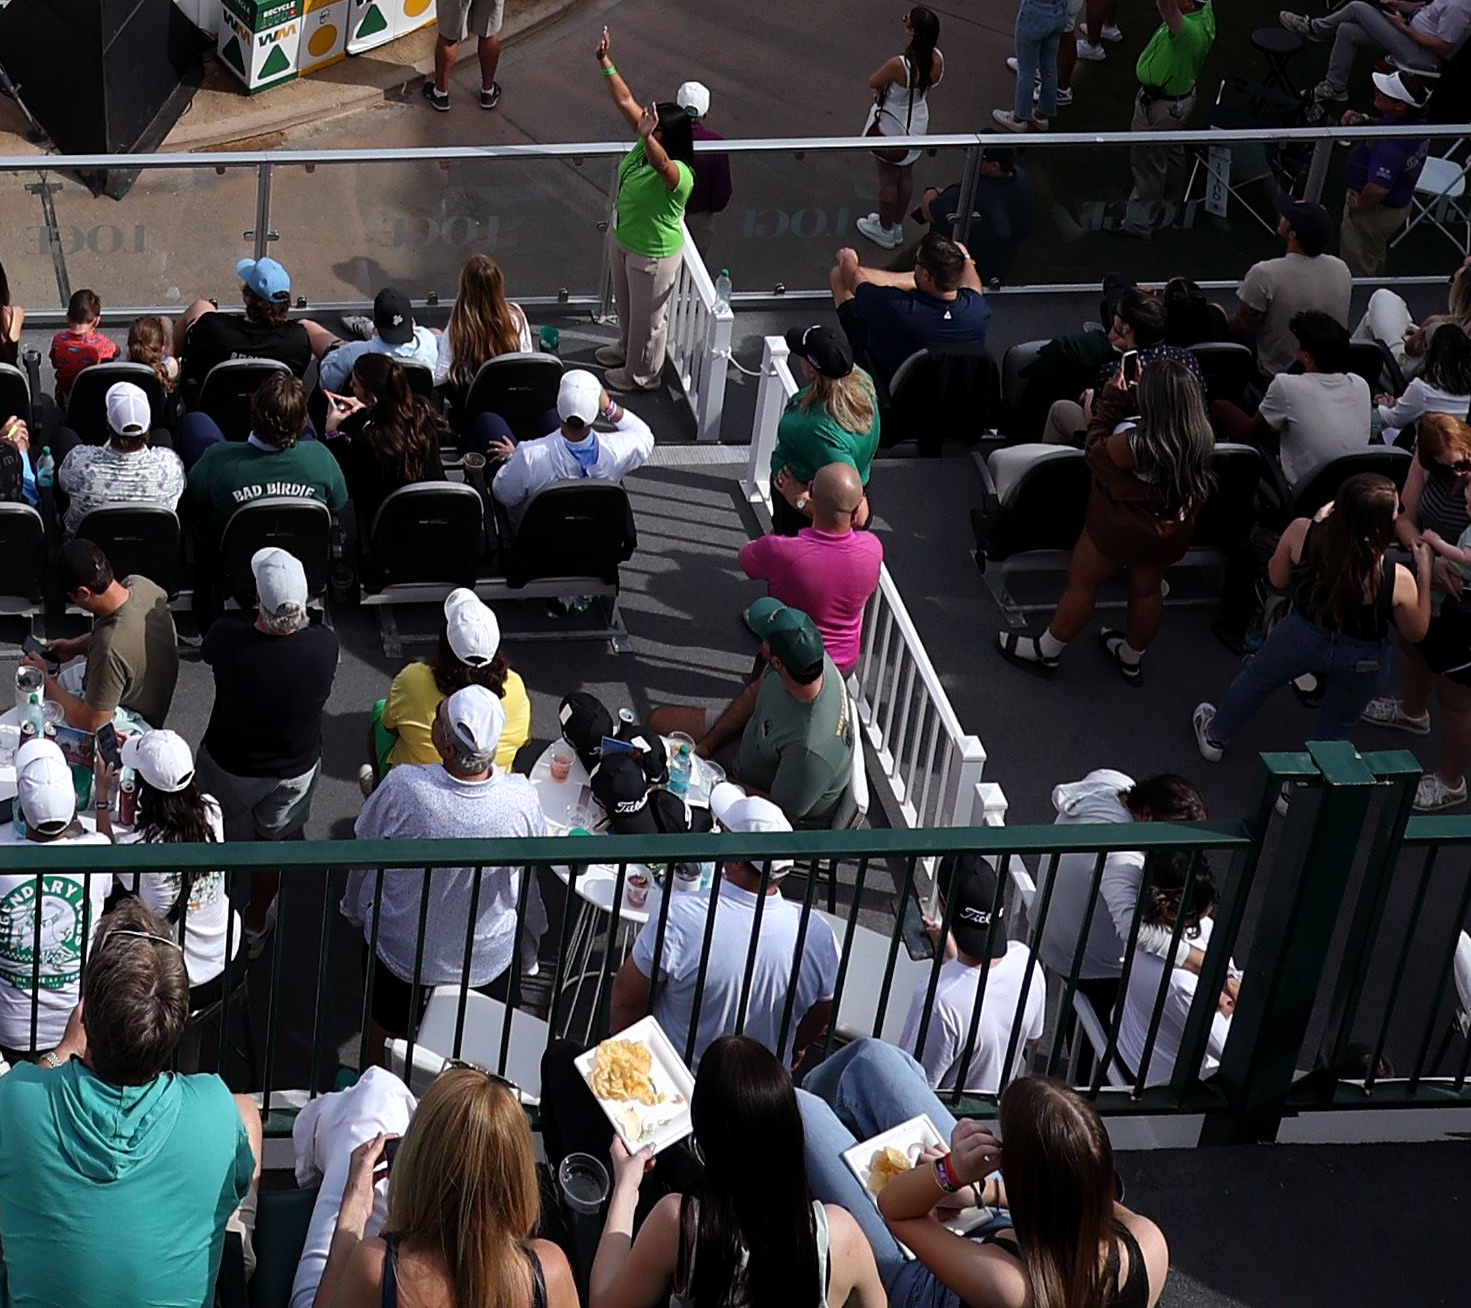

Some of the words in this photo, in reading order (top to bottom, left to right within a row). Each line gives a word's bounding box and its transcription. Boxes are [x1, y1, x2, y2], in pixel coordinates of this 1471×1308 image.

[262, 1, 296, 17] RECYCLE
[223, 9, 251, 46] WM
[258, 24, 297, 47] WM
[232, 483, 263, 502] BAD
[266, 481, 316, 498] BIRDIE
